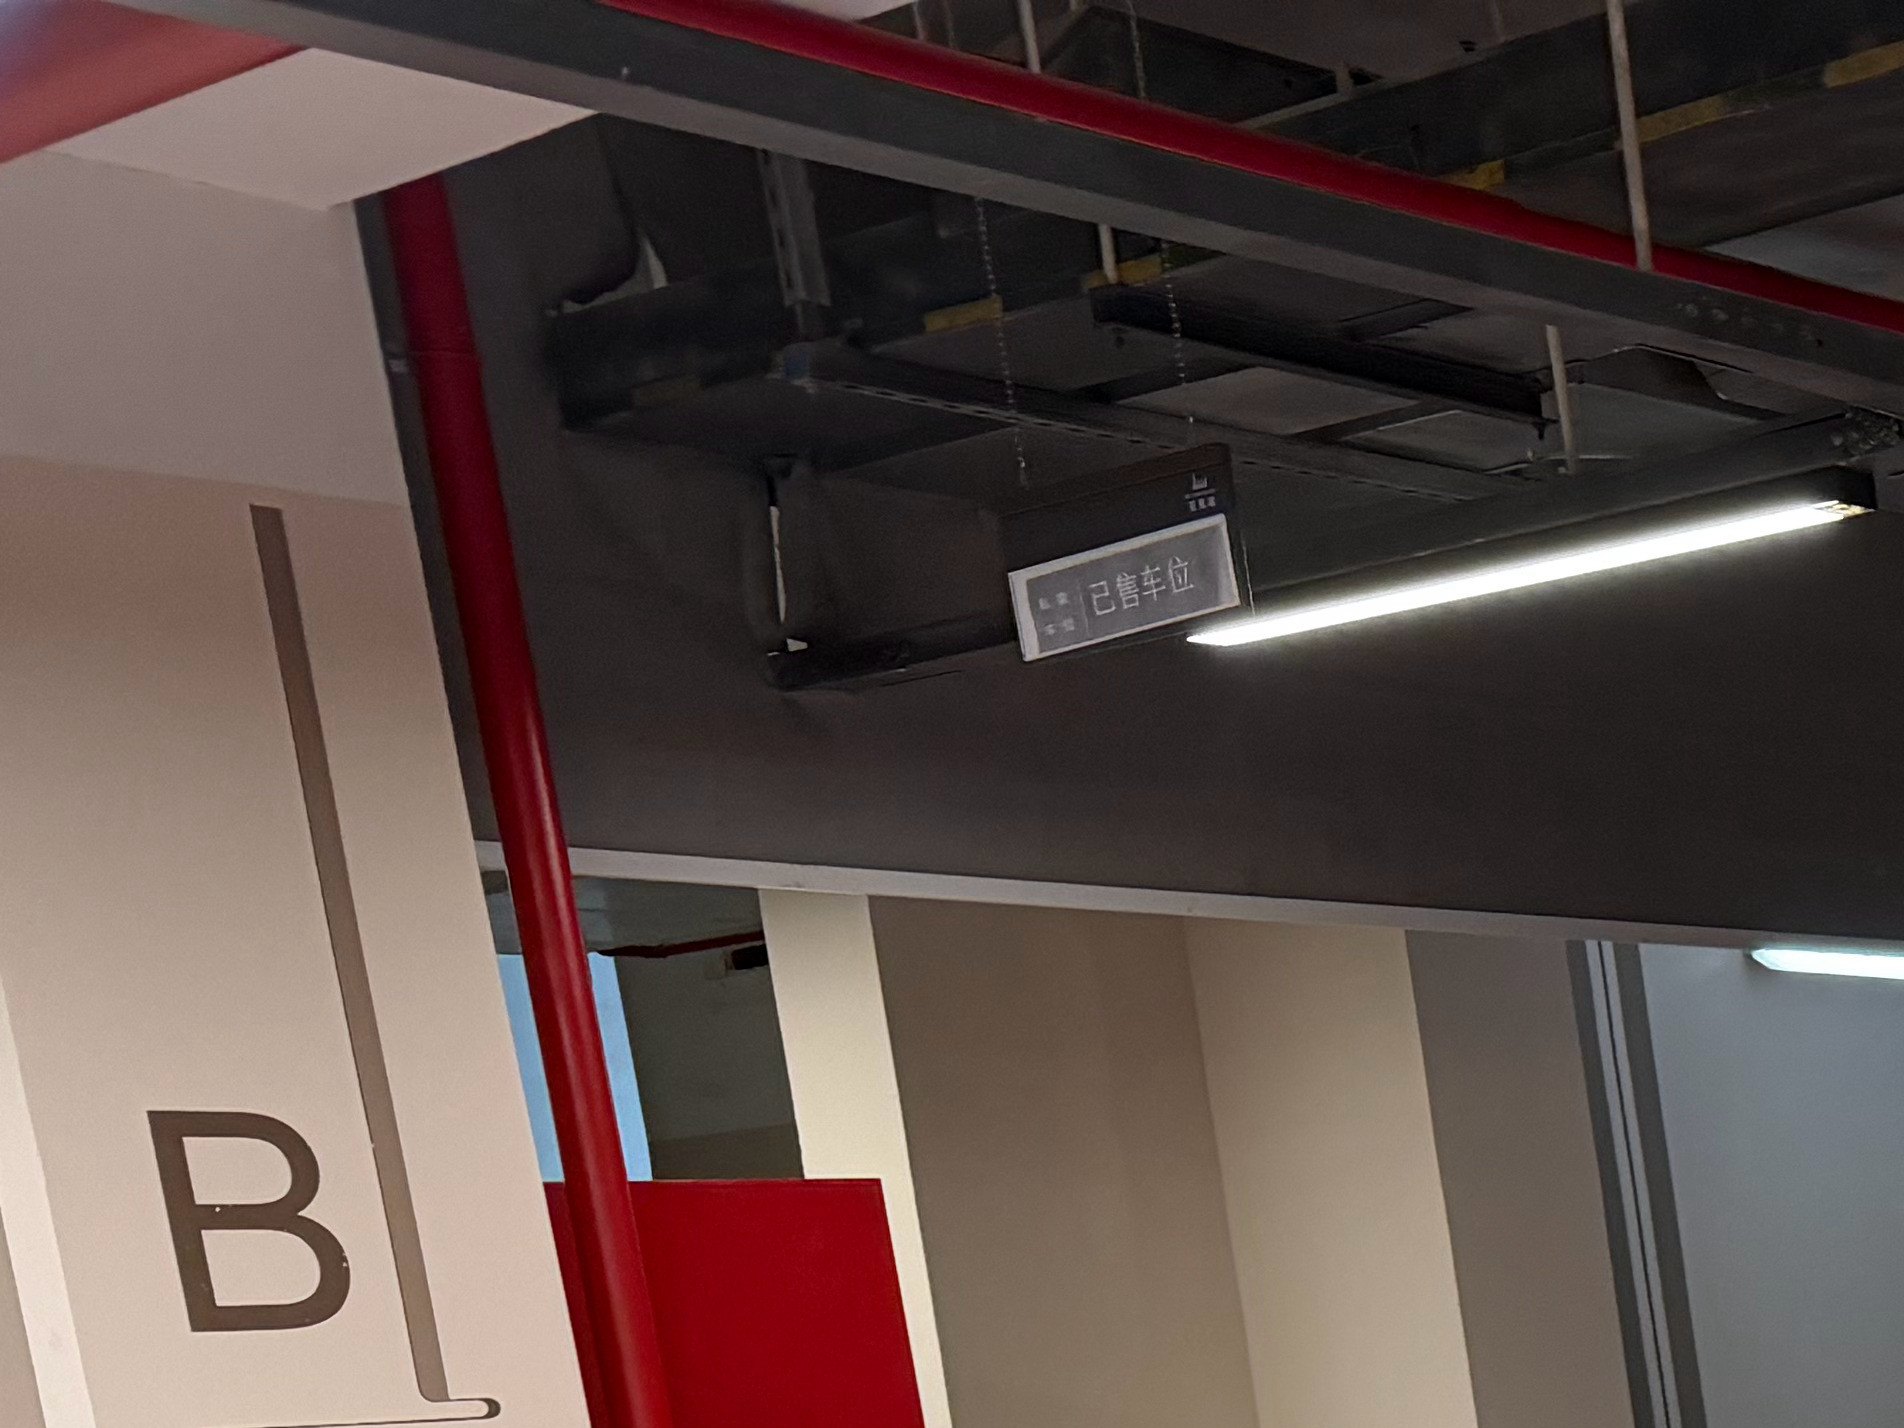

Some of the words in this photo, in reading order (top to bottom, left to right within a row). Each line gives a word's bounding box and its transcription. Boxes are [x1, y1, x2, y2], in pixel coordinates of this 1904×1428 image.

[1089, 556, 1194, 616] 已售车位
[146, 1110, 351, 1333] B
